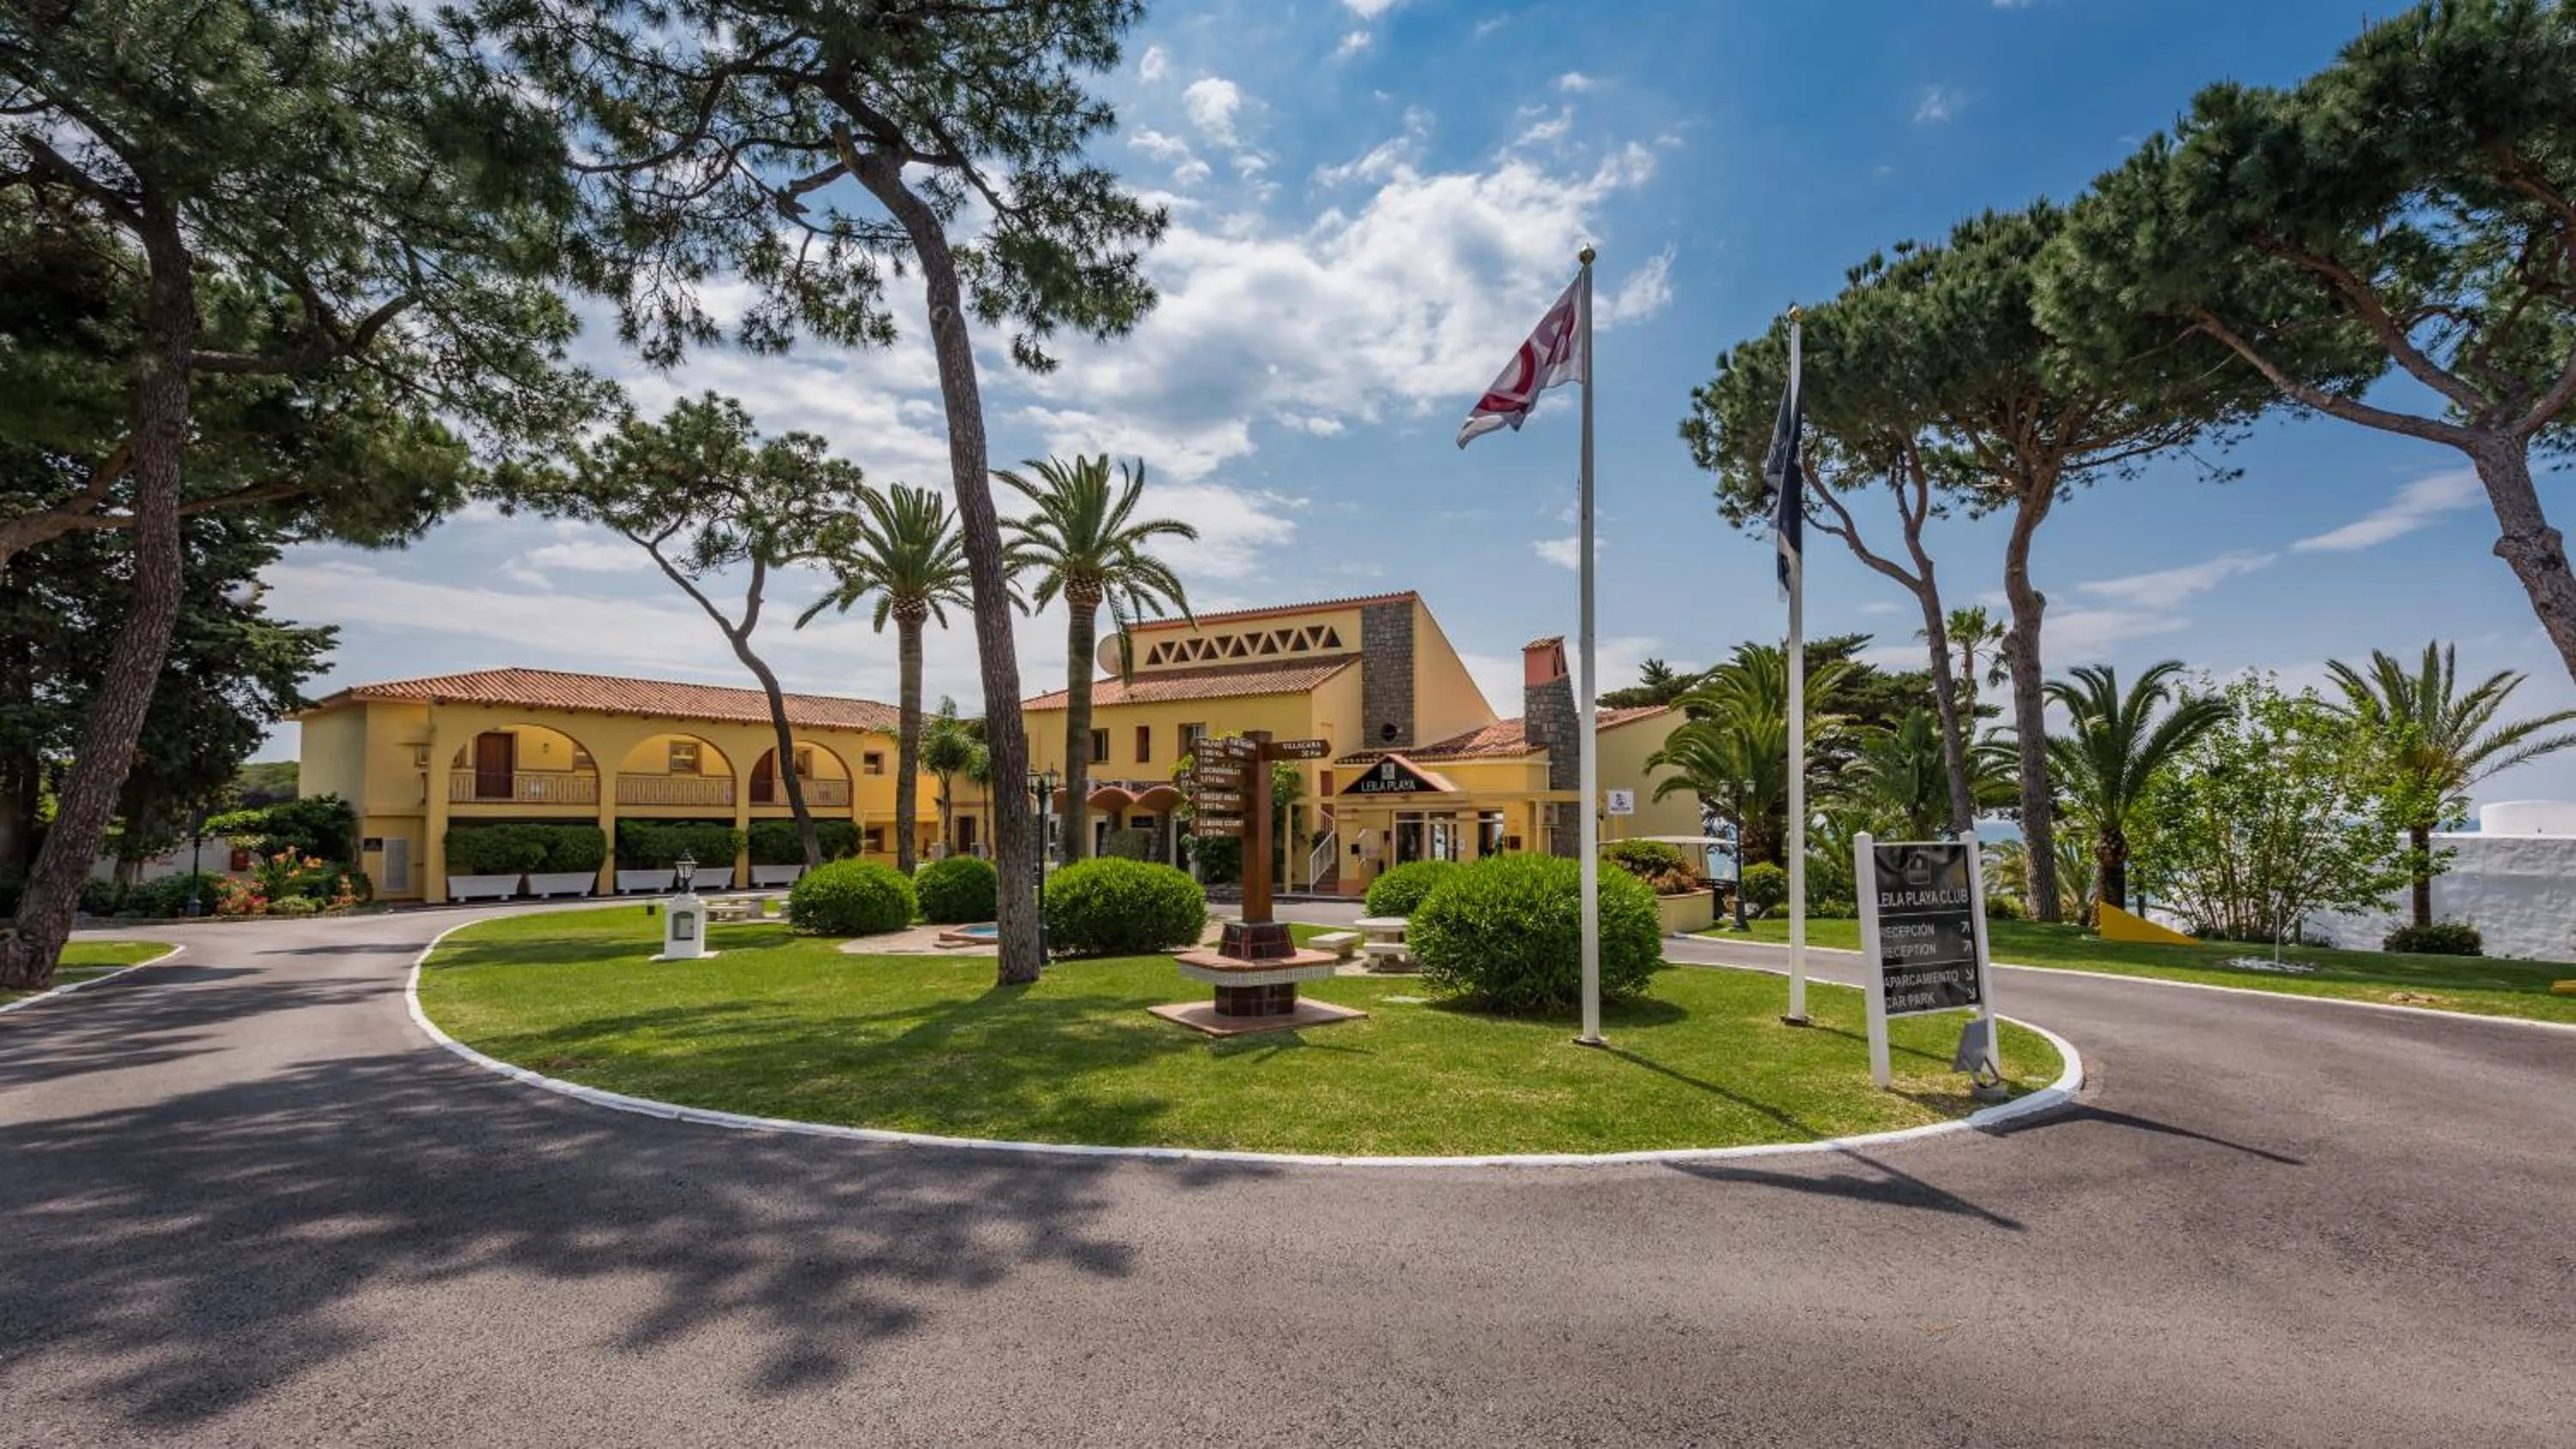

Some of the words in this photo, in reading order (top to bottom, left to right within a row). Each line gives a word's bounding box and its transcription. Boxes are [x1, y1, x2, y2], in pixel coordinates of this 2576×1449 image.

[1387, 779, 1416, 791] PLAYA
[1905, 890, 1938, 906] PLAYA
[1940, 888, 1969, 904] CLUB
[1885, 969, 1959, 988] APARCAMIENTO
[1907, 992, 1936, 1006] PARK
